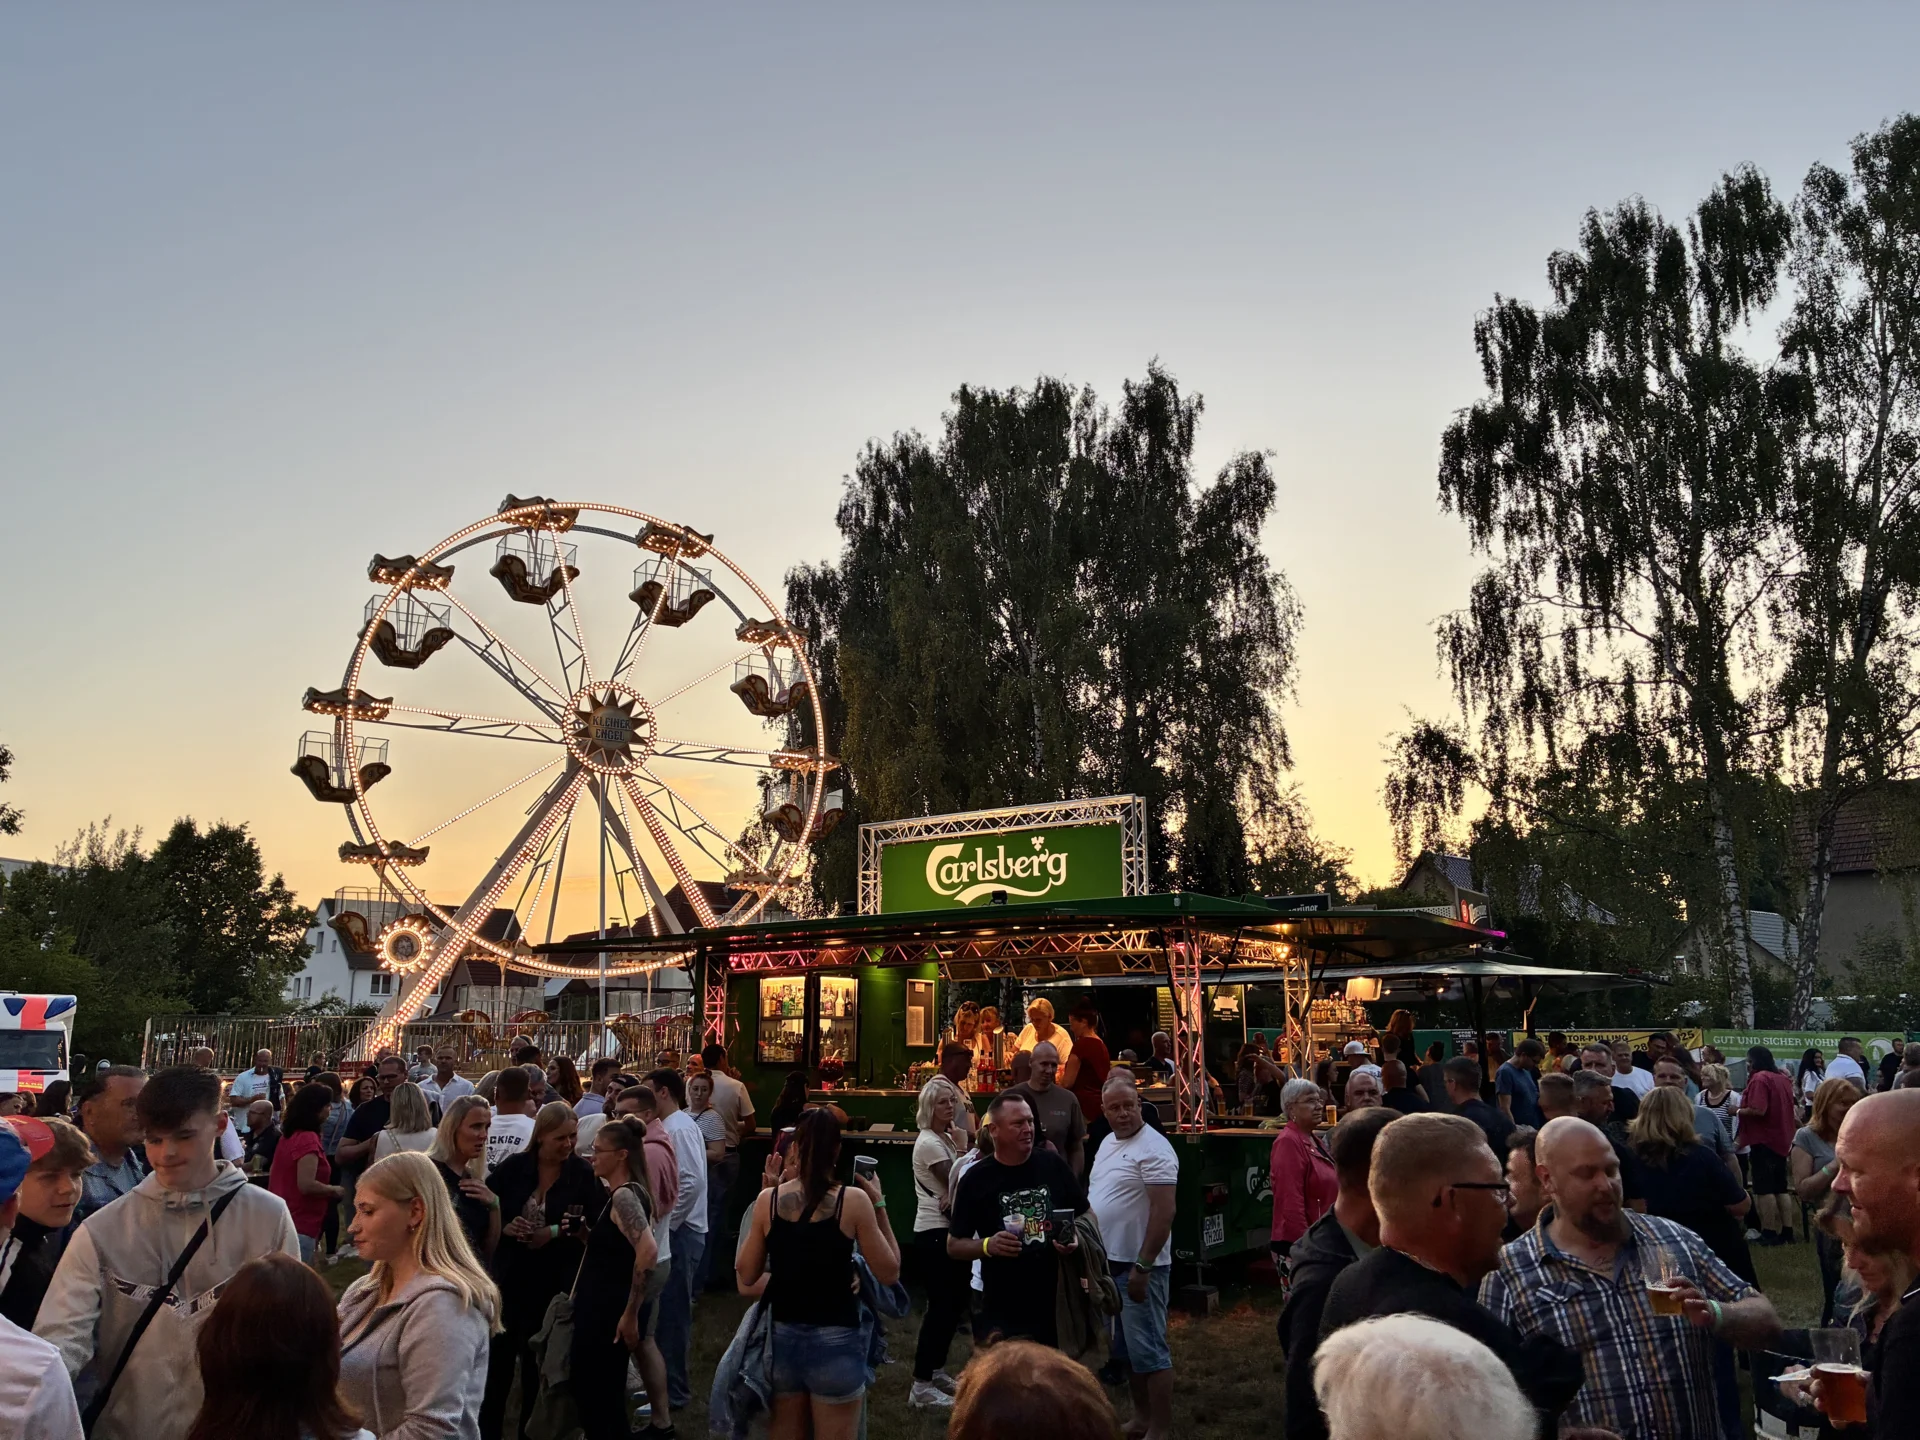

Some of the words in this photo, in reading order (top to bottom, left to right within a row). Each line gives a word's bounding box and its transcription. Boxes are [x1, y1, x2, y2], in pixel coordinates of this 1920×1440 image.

[592, 715, 632, 729] KLEINER
[595, 728, 624, 741] ENGEL
[926, 843, 1068, 895] Carlsberg
[1544, 1034, 1628, 1042] TTOR-PULLING
[1713, 1036, 1735, 1044] GUT
[1737, 1037, 1761, 1045] UND
[1763, 1037, 1802, 1046] SICHER
[1804, 1038, 1840, 1047] WOHN
